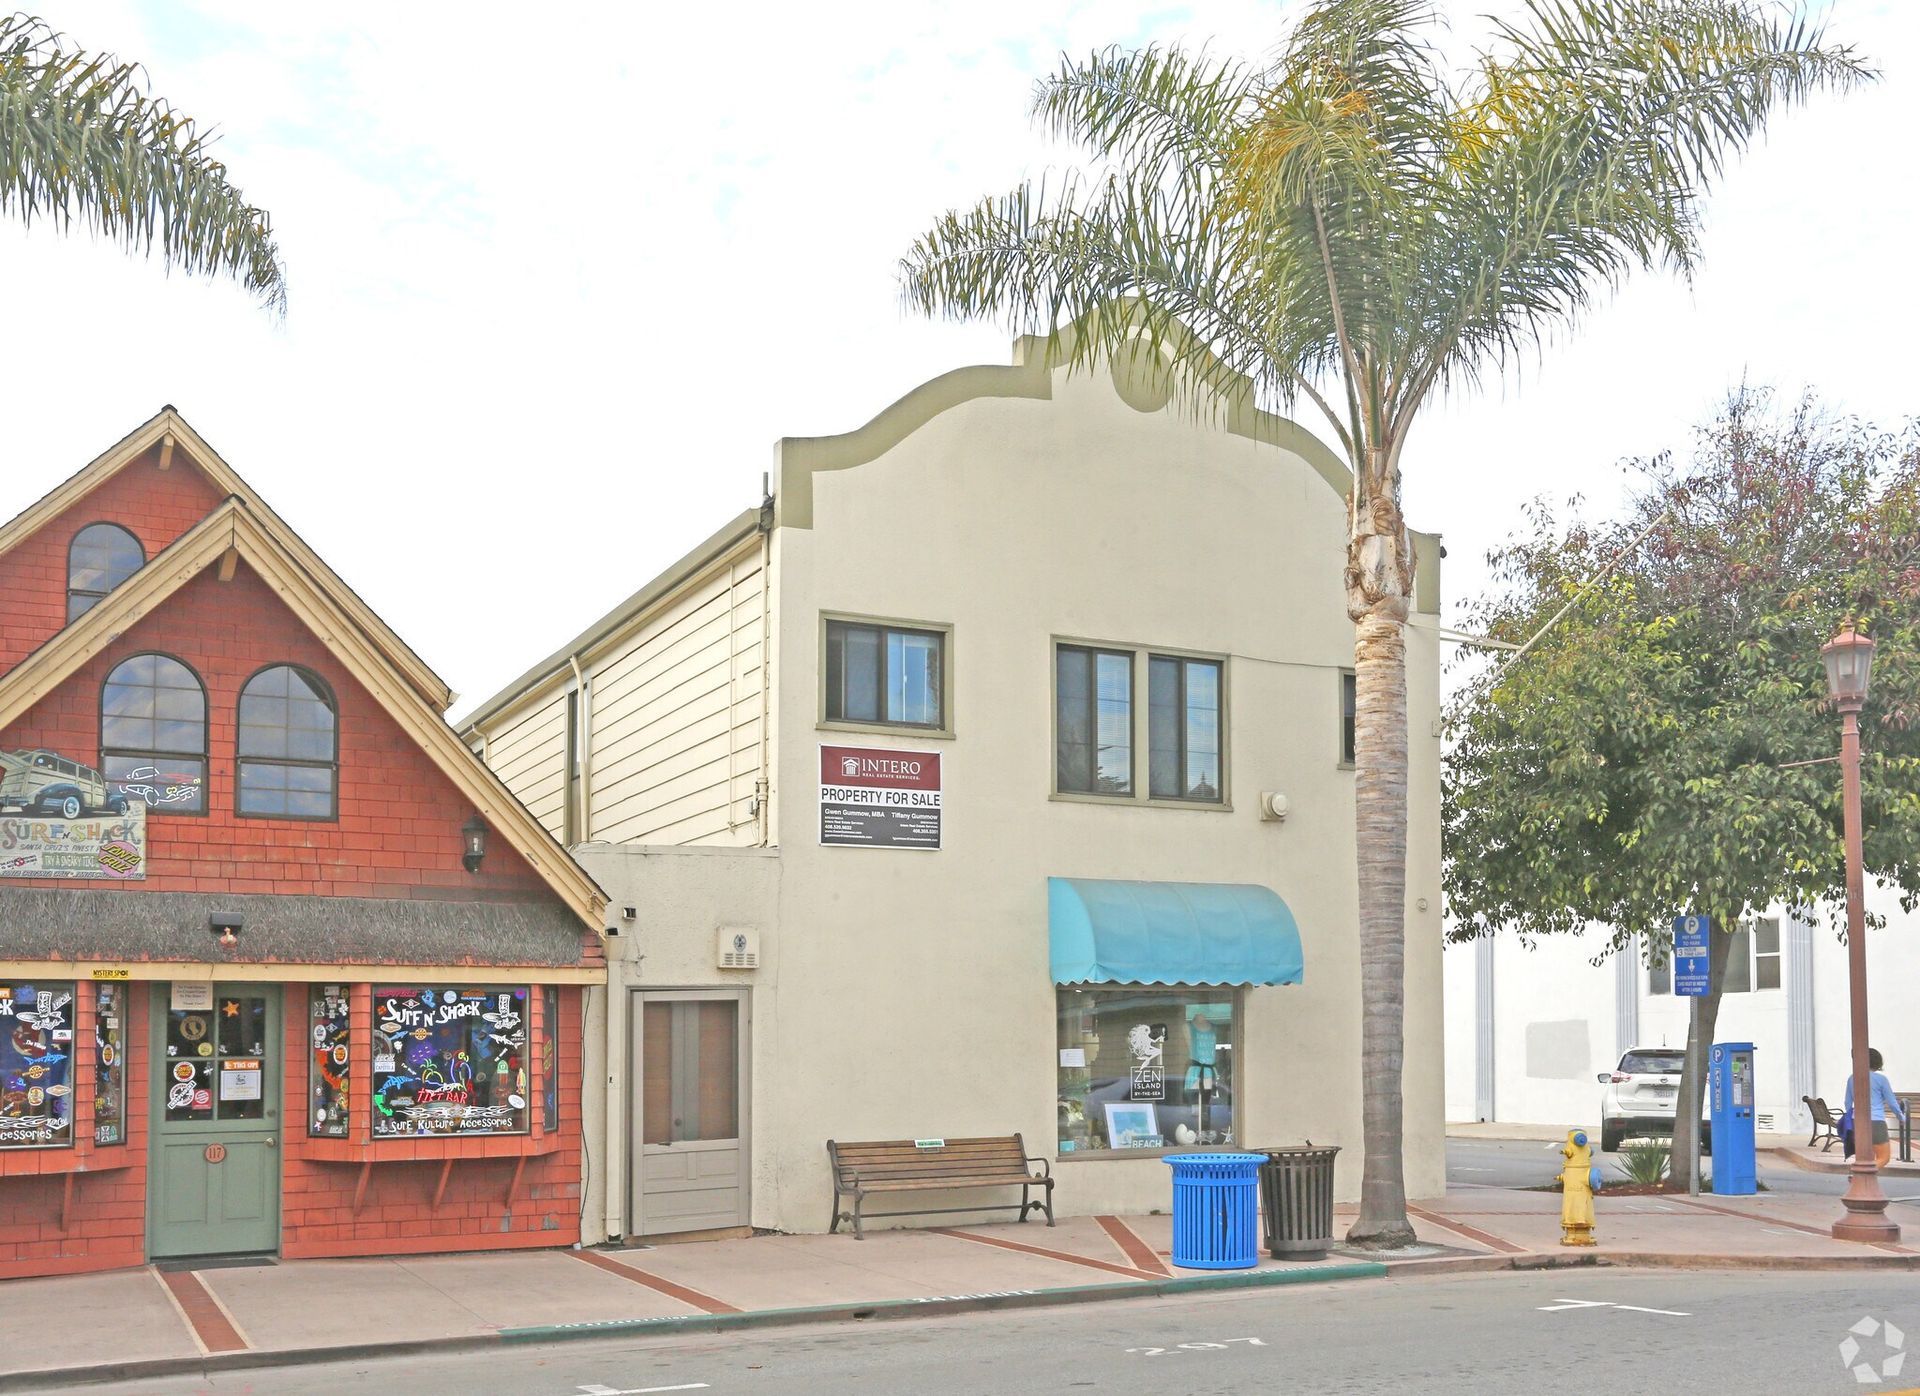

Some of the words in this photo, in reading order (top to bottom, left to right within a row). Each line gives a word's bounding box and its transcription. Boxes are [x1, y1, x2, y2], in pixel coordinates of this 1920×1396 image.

[862, 758, 921, 775] INTERO
[822, 788, 882, 803] PROPERTY
[886, 791, 908, 805] FOR
[911, 793, 940, 806] SALE
[825, 808, 841, 816] Gwen
[891, 812, 910, 820] Tiffany
[2, 818, 65, 850] SURF
[70, 819, 141, 845] SHACK
[100, 844, 142, 866] SANTA
[98, 854, 133, 874] CRUZ
[1678, 948, 1683, 956] 3
[1134, 1070, 1161, 1083] ZEN
[1134, 1082, 1161, 1090] ISLAND
[446, 1091, 468, 1104] BAR
[1132, 1139, 1162, 1148] BEACH
[208, 1147, 222, 1160] 117
[1125, 1337, 1269, 1356] 297
